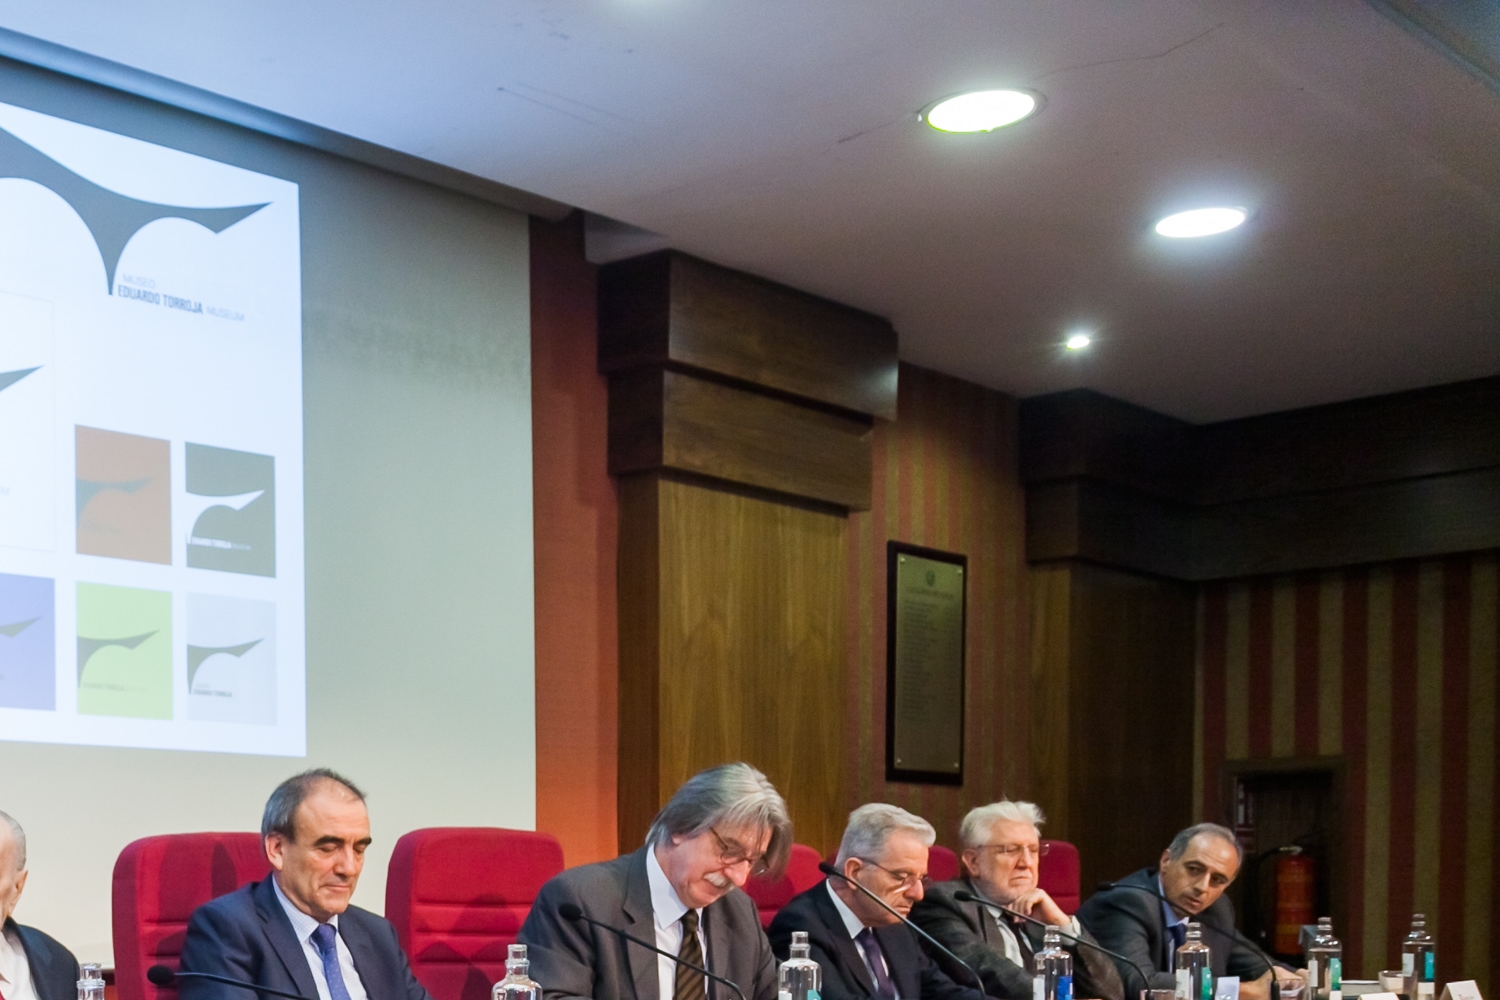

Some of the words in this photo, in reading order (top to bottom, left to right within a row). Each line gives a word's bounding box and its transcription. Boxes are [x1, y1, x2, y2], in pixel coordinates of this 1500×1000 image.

[122, 272, 156, 289] MUSEO
[118, 284, 161, 306] EDUARDO
[162, 294, 204, 315] TORROJA
[206, 305, 245, 322] MUSEUM
